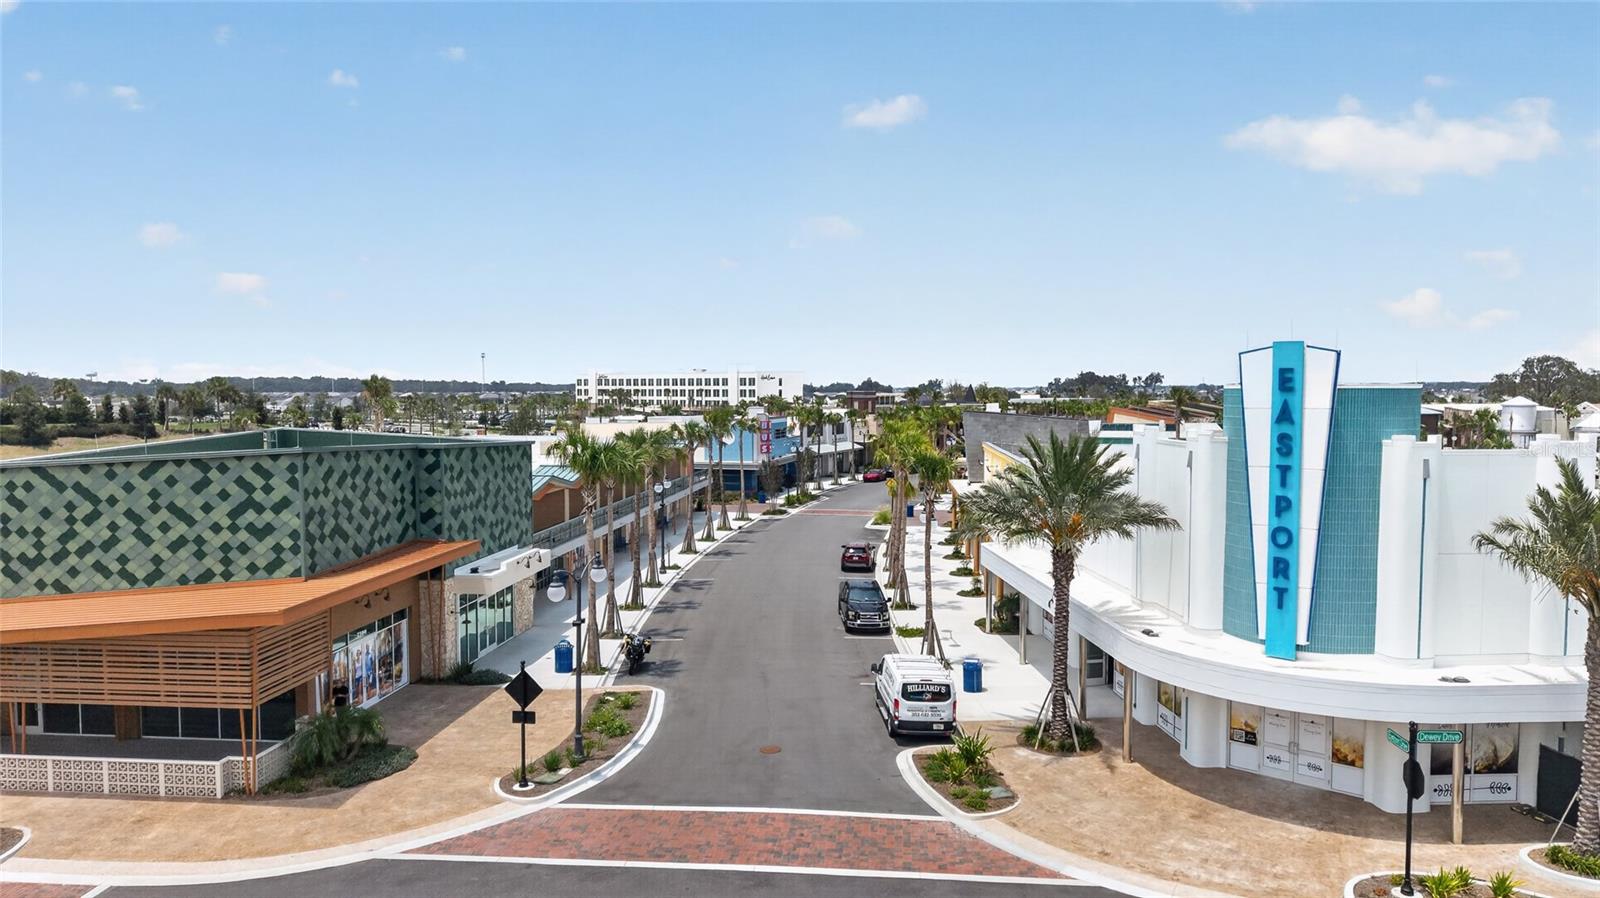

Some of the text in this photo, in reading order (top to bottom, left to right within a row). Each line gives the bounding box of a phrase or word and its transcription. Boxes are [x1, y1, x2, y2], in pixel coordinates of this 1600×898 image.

[1271, 367, 1296, 611] EASTPORT
[907, 684, 946, 694] HILLIARD'S
[1420, 732, 1460, 741] Dewey Drive
